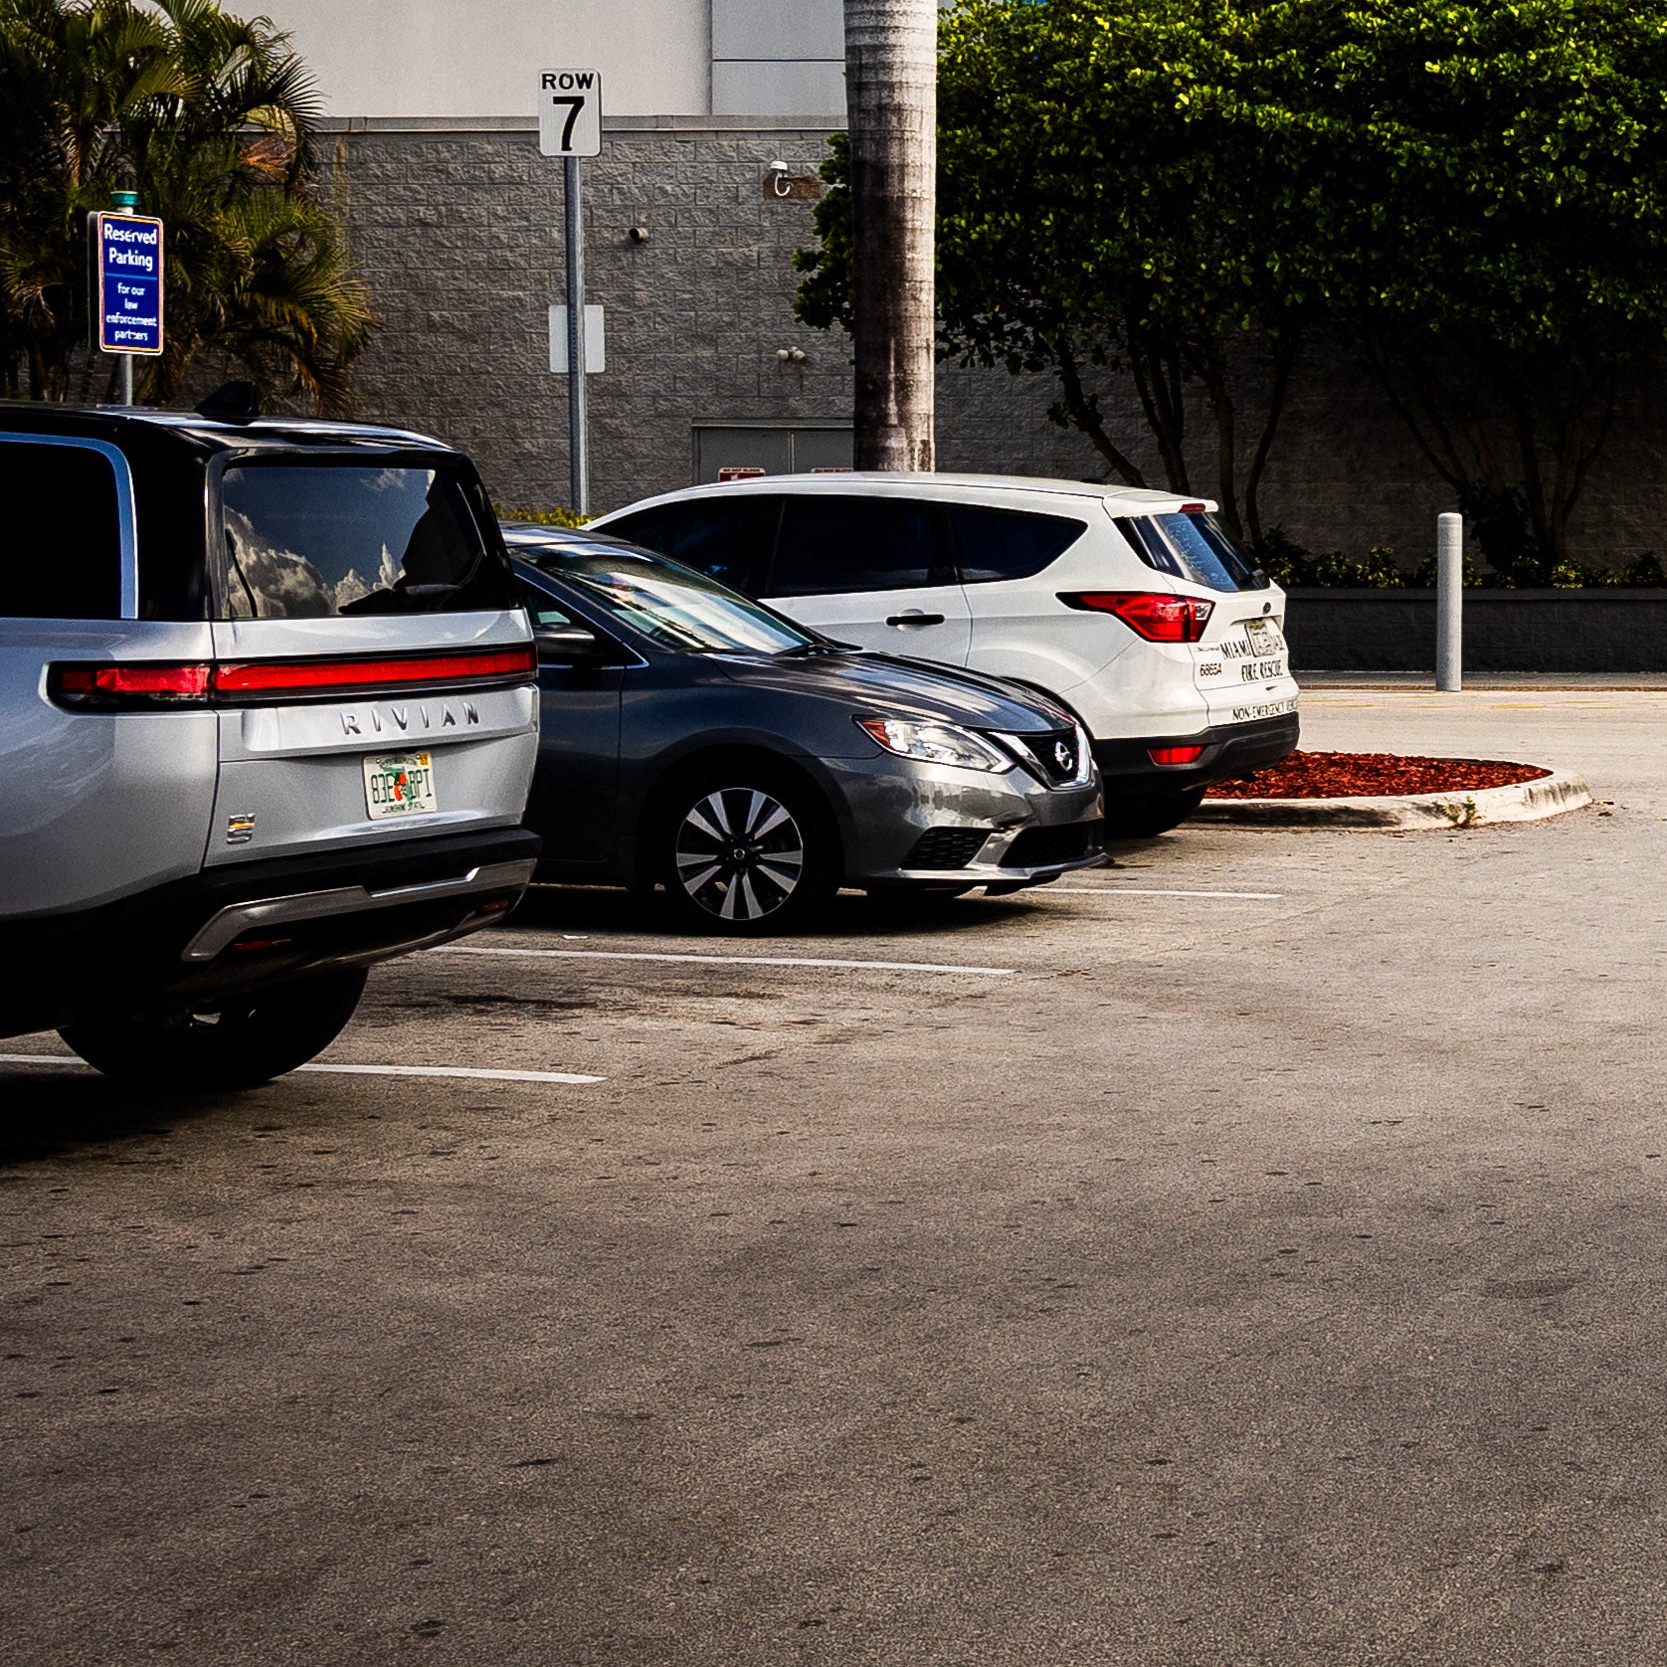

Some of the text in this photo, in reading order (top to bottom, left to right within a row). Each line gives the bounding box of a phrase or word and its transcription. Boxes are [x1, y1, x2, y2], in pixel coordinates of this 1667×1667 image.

[541, 73, 594, 90] ROW
[552, 96, 585, 152] 7
[104, 223, 157, 245] Reserved
[109, 247, 153, 272] Parking
[117, 282, 145, 296] for our
[124, 298, 138, 310] law
[106, 312, 157, 326] enforcement
[114, 329, 148, 341] partners
[1241, 659, 1284, 682] FIRE RESCUE
[339, 701, 480, 735] RIVIAN
